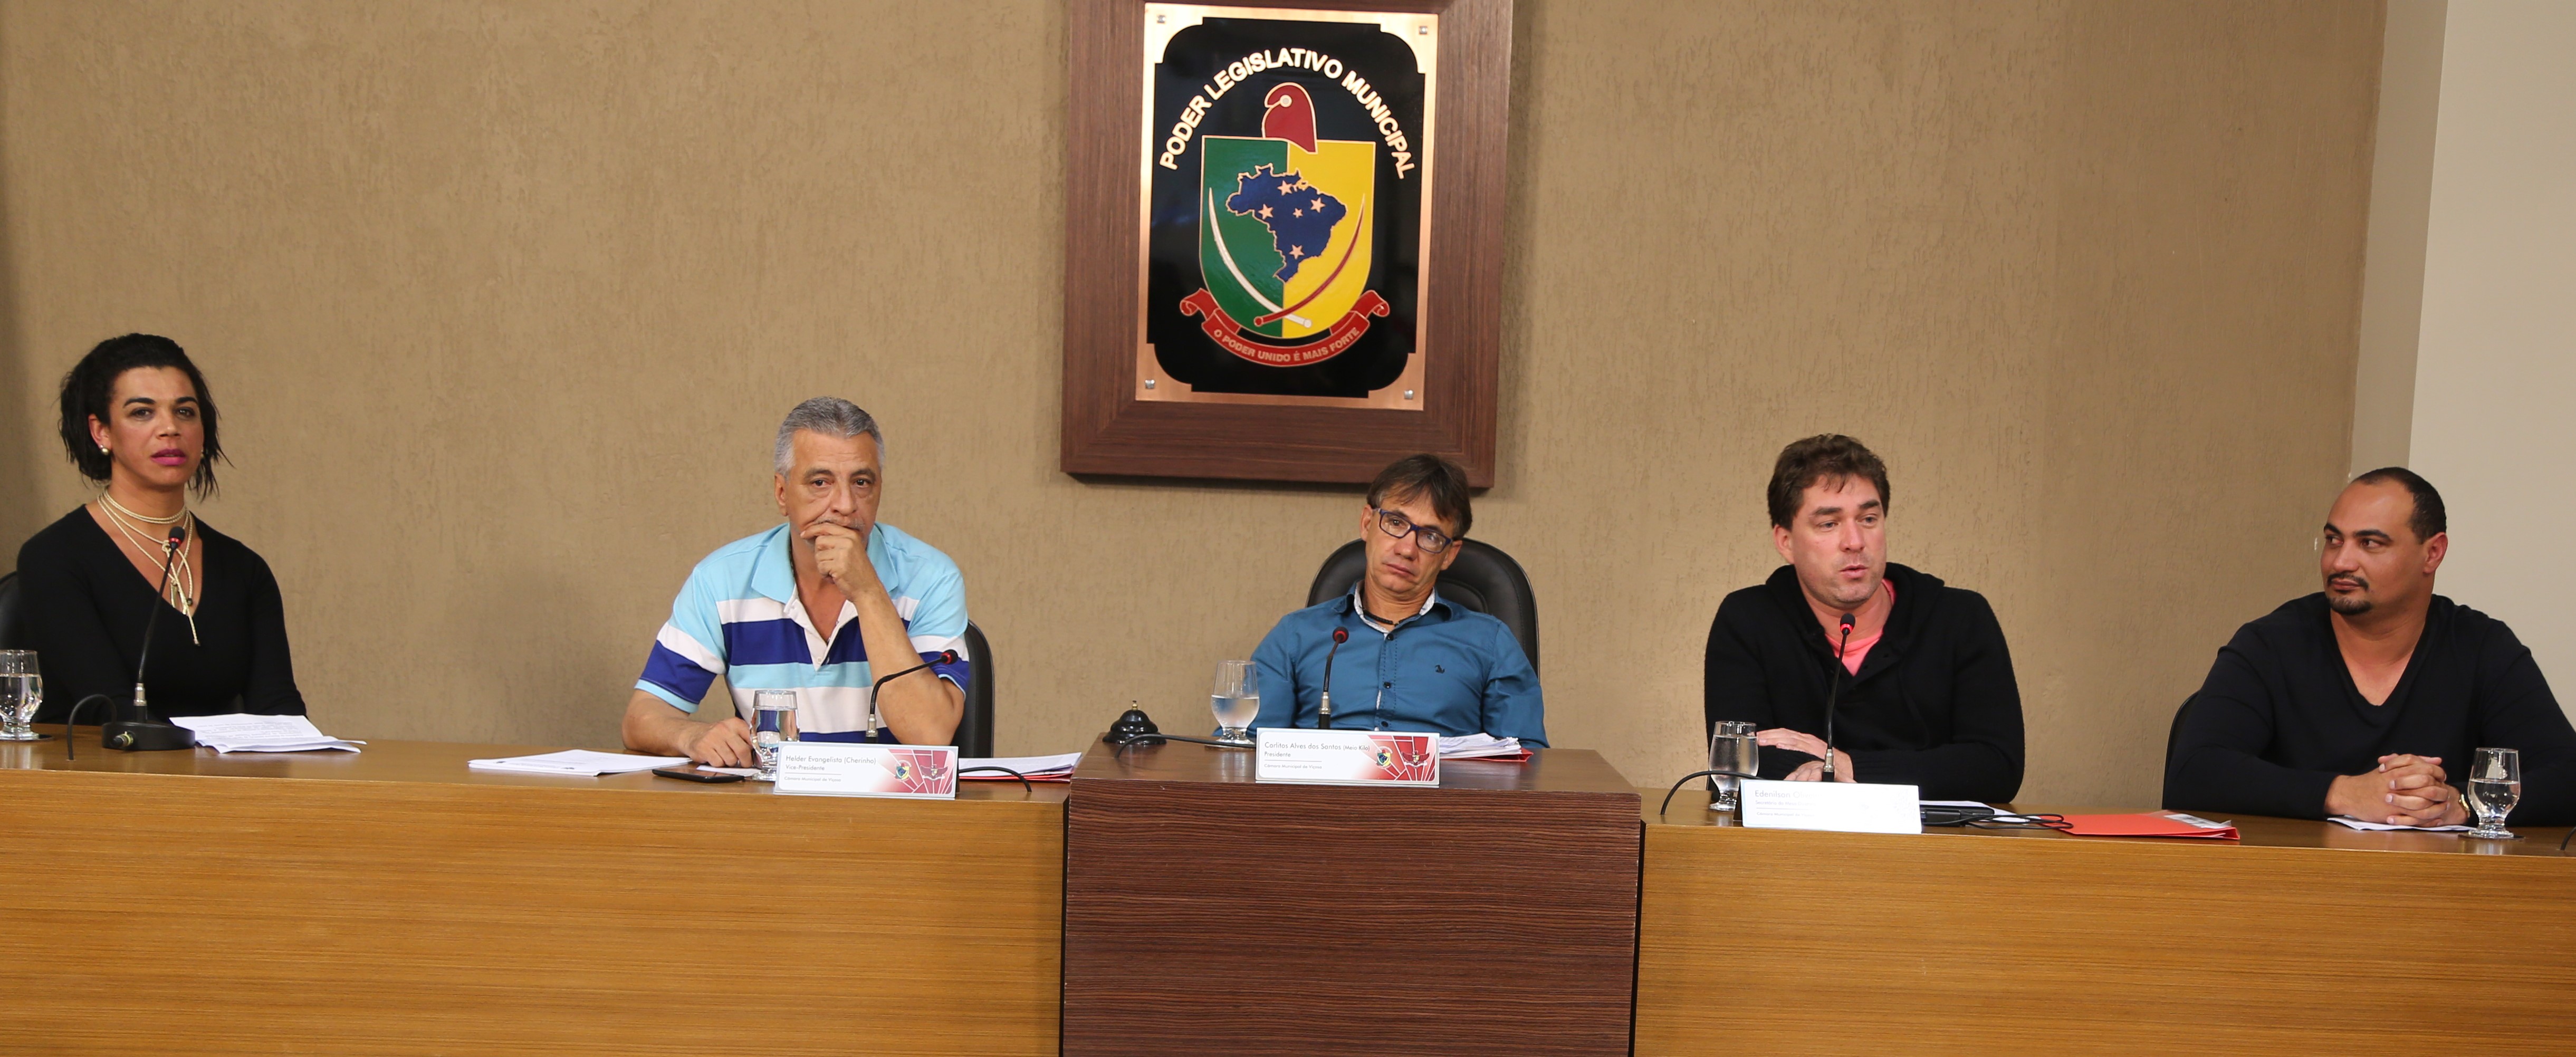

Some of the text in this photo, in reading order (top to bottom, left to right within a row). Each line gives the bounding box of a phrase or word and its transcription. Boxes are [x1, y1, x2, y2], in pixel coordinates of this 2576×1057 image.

[1160, 47, 1415, 180] PODER LEGISLATIVO MUNICIPAL
[1213, 326, 1360, 362] O PODER UNIDO É MAIS FORTE
[1755, 790, 1822, 799] Edenilson Olive
